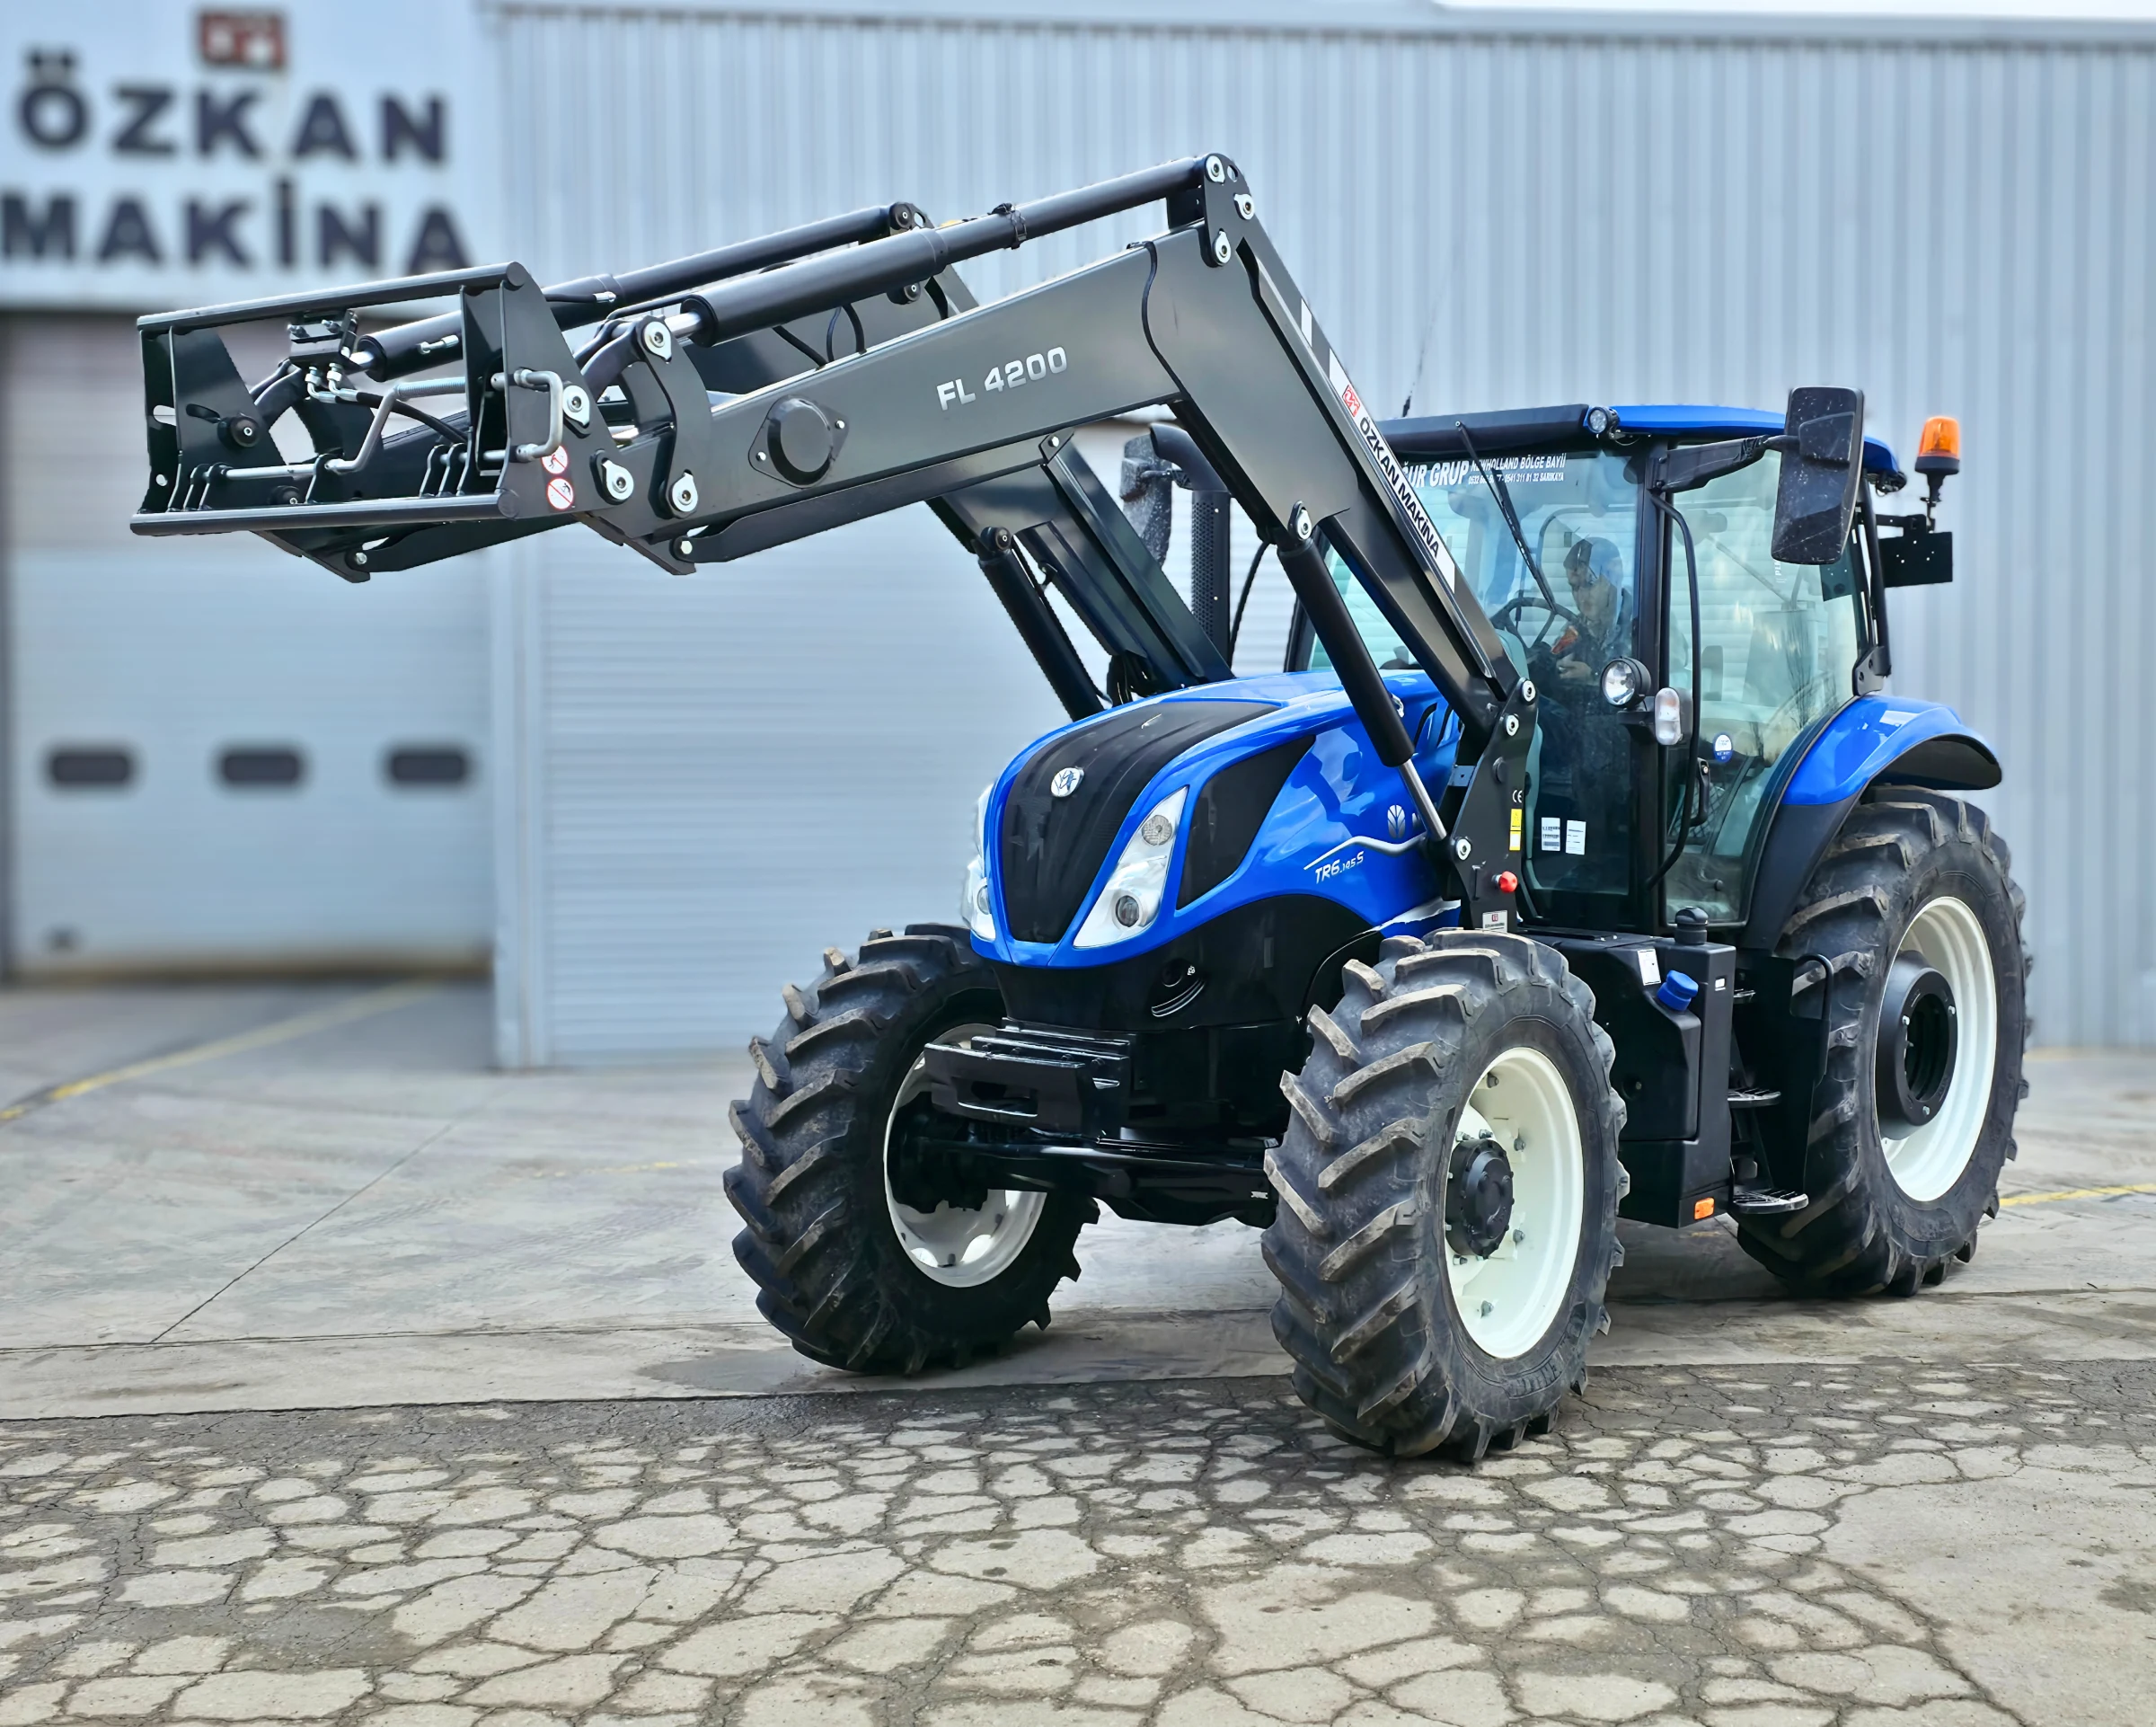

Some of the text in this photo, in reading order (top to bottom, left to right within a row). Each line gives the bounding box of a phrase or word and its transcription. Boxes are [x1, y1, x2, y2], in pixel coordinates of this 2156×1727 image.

[17, 49, 446, 164] ÖZKAN
[1, 180, 473, 275] MAKİNA
[936, 346, 1067, 411] FL 4200
[1359, 416, 1440, 558] ÖZKAN MAKİNA
[1429, 460, 1469, 487] GRUP
[1520, 454, 1545, 469] BÖLGE
